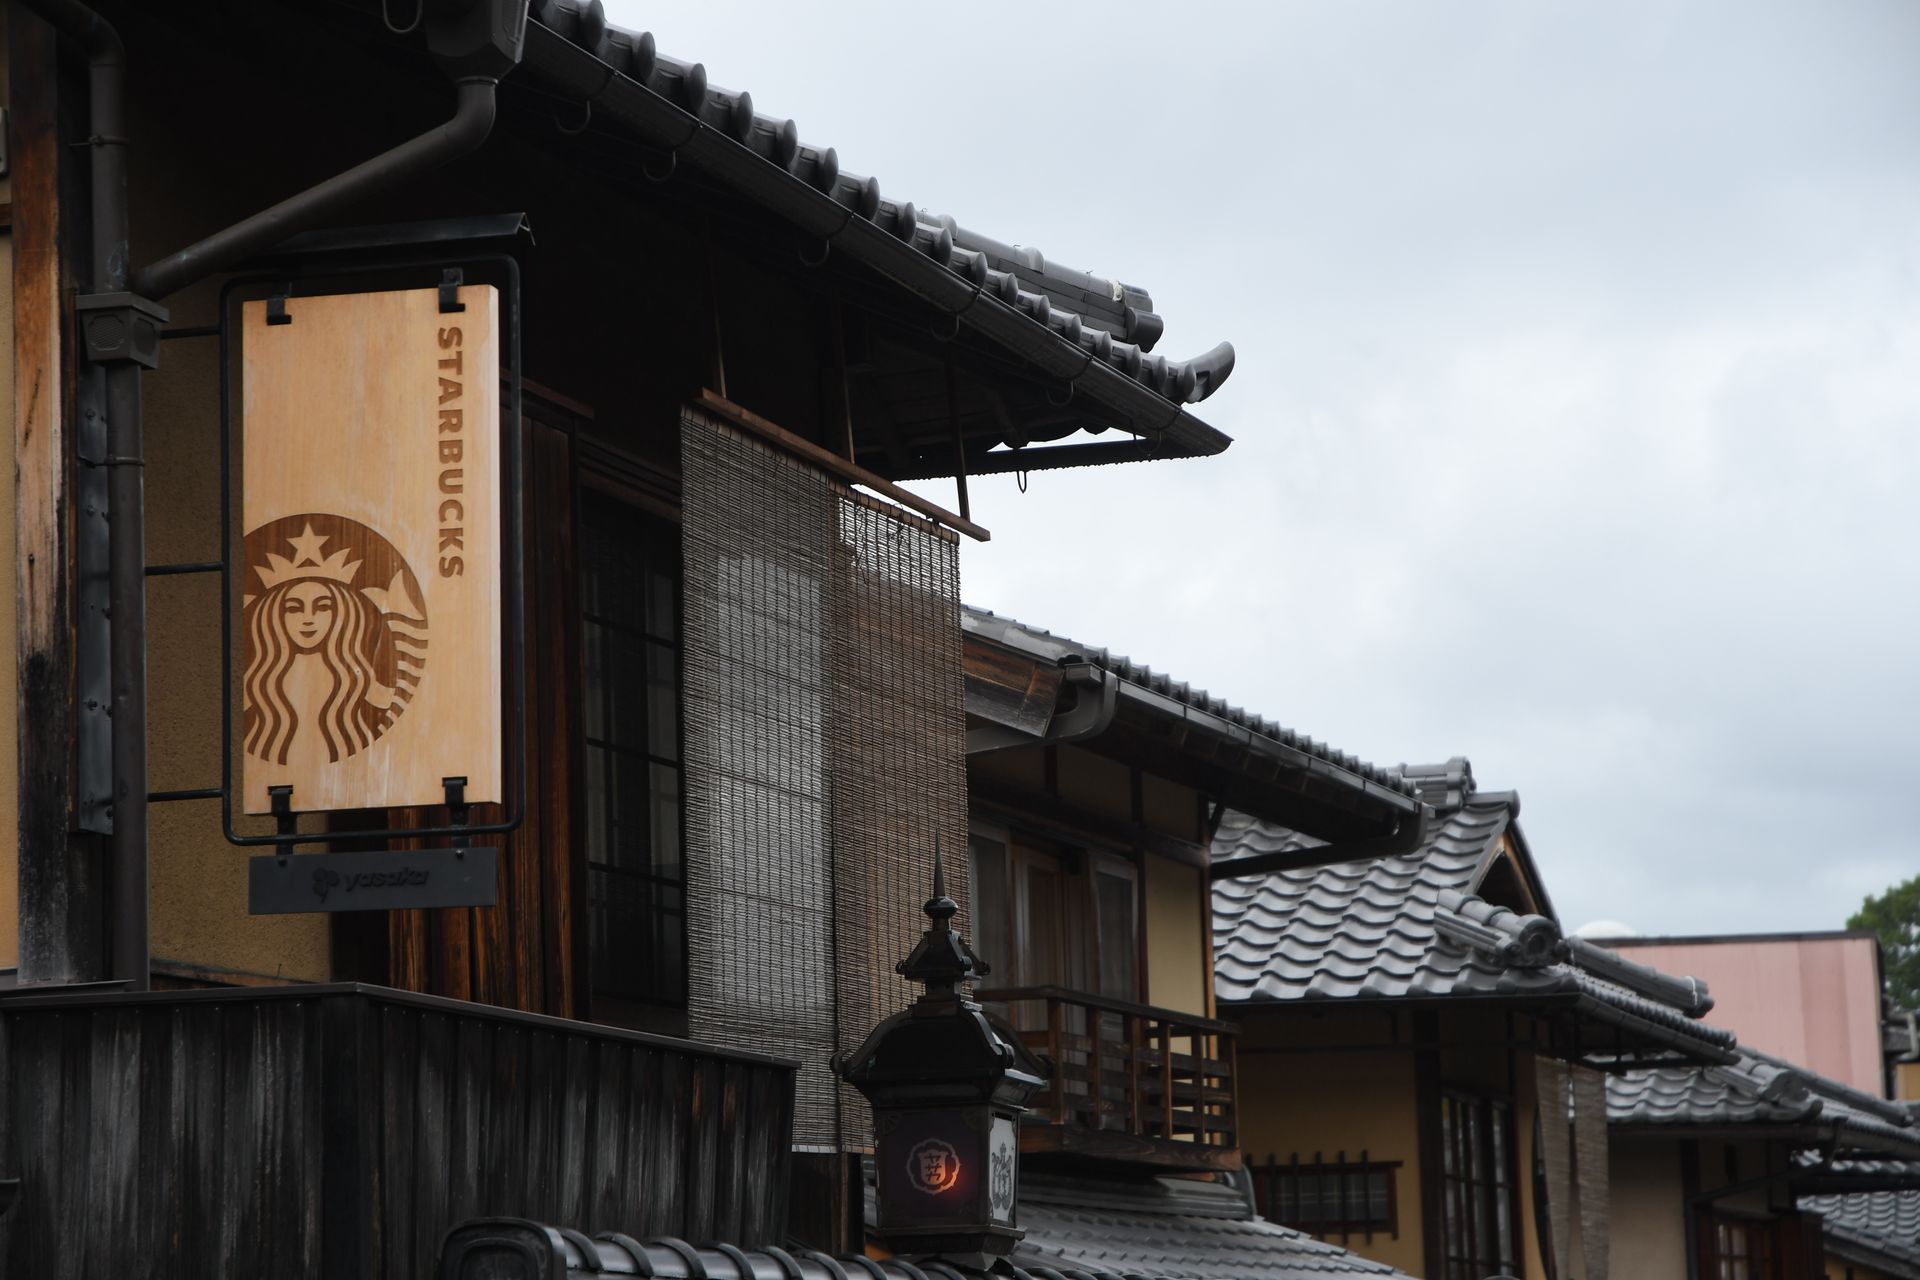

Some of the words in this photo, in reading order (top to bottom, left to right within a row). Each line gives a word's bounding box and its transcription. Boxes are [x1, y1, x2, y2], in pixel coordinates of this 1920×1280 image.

[437, 326, 465, 578] STARBUCKS
[344, 866, 430, 892] yasaka
[923, 1153, 942, 1181] ヤサカ
